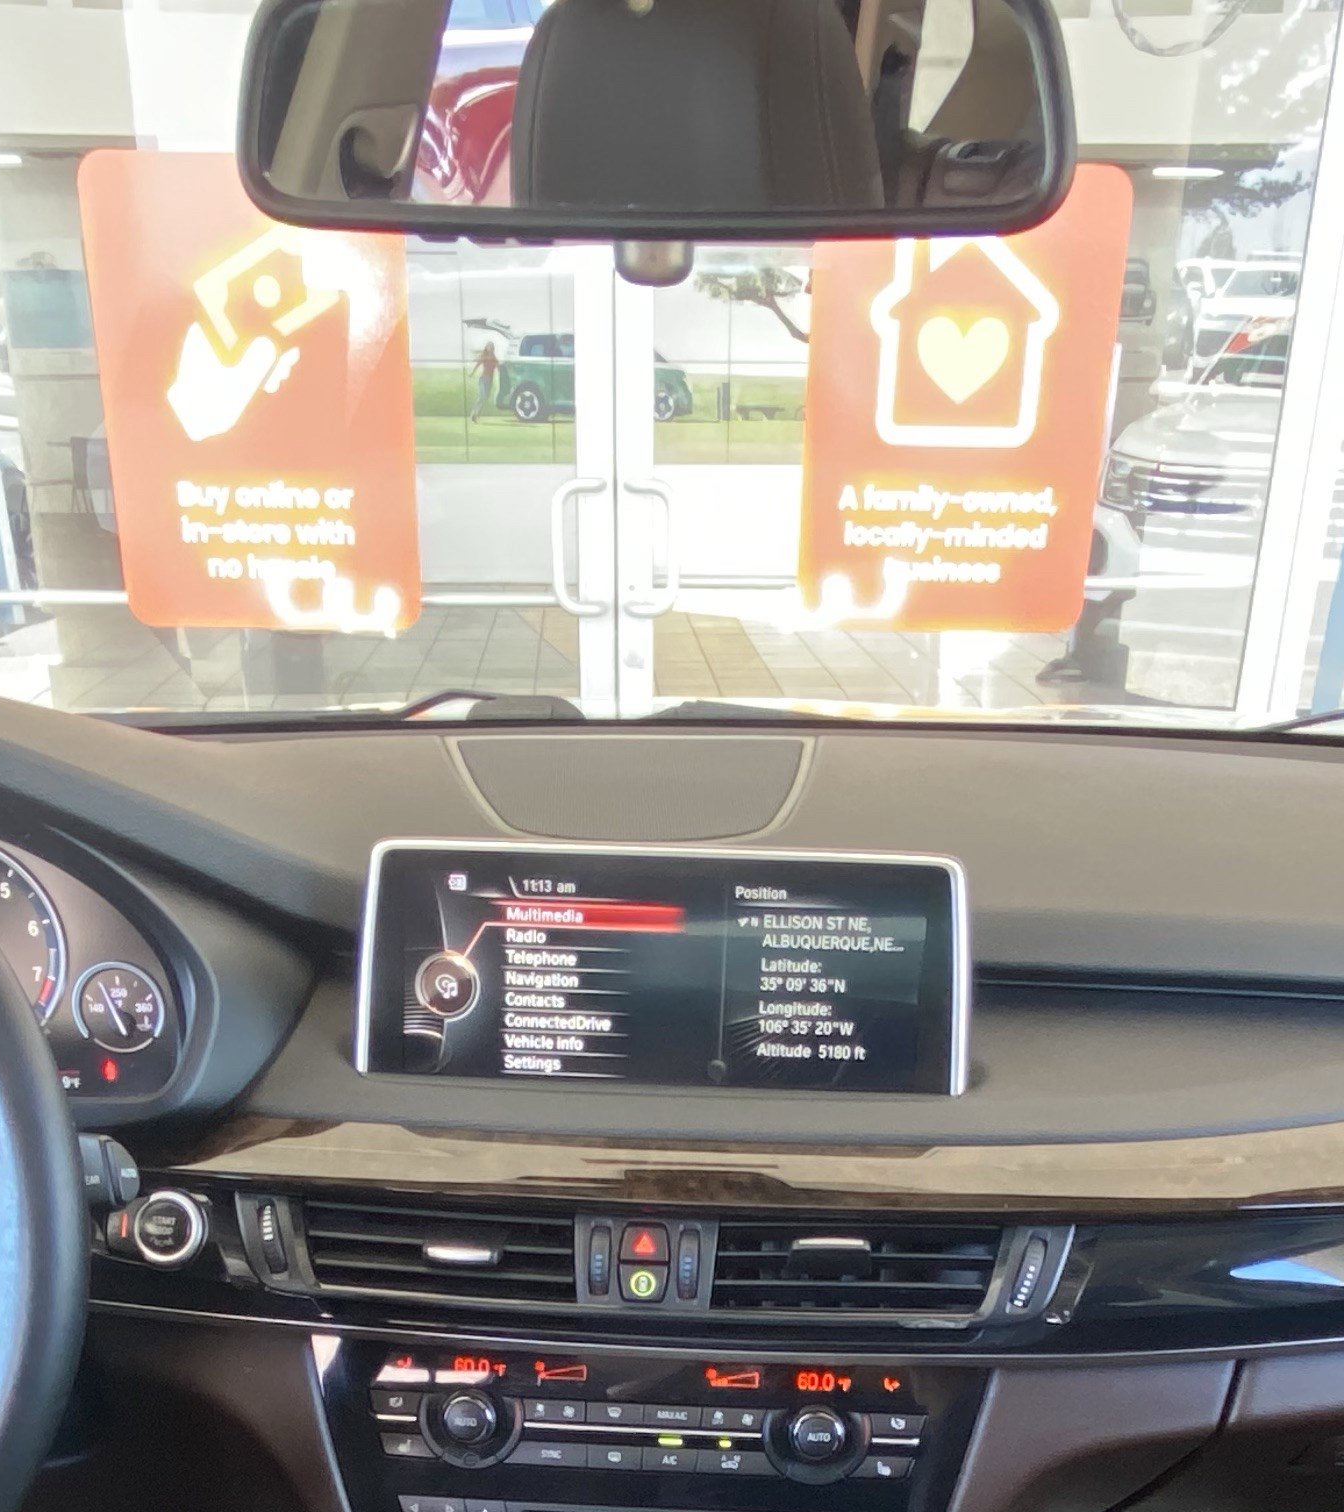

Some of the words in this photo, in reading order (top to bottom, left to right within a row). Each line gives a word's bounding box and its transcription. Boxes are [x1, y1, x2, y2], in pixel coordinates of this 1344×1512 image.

[177, 480, 230, 516] Buy
[234, 480, 321, 510] online
[324, 487, 355, 510] or
[838, 484, 859, 512] A
[863, 482, 1058, 521] family-owned,
[180, 515, 292, 545] in-store
[294, 518, 356, 546] with
[843, 520, 1049, 555] locally-minded
[207, 556, 244, 579] no
[0, 883, 11, 898] 5
[522, 879, 553, 893] 11:13
[556, 881, 577, 894] am
[735, 885, 788, 900] Position
[506, 907, 584, 924] Multimedia
[763, 914, 823, 930] ELLISON
[826, 916, 845, 931] ST
[848, 916, 872, 934] NE,
[27, 920, 39, 936] 6
[506, 928, 547, 944] Radio
[505, 949, 578, 968] Telephone
[760, 957, 823, 974] Latitude:
[31, 965, 43, 981] 7
[505, 971, 579, 989] Navigation
[505, 992, 566, 1009] Contacts
[758, 1000, 833, 1018] Longitude:
[505, 1012, 613, 1032] ConnectedDrive
[504, 1034, 555, 1050] Vehicle
[757, 1042, 812, 1059] Altitude
[817, 1045, 852, 1060] 5180
[853, 1046, 867, 1061] ft
[504, 1054, 562, 1074] Settings
[796, 1372, 835, 1391] 60.0
[806, 1431, 831, 1443] AUTO
